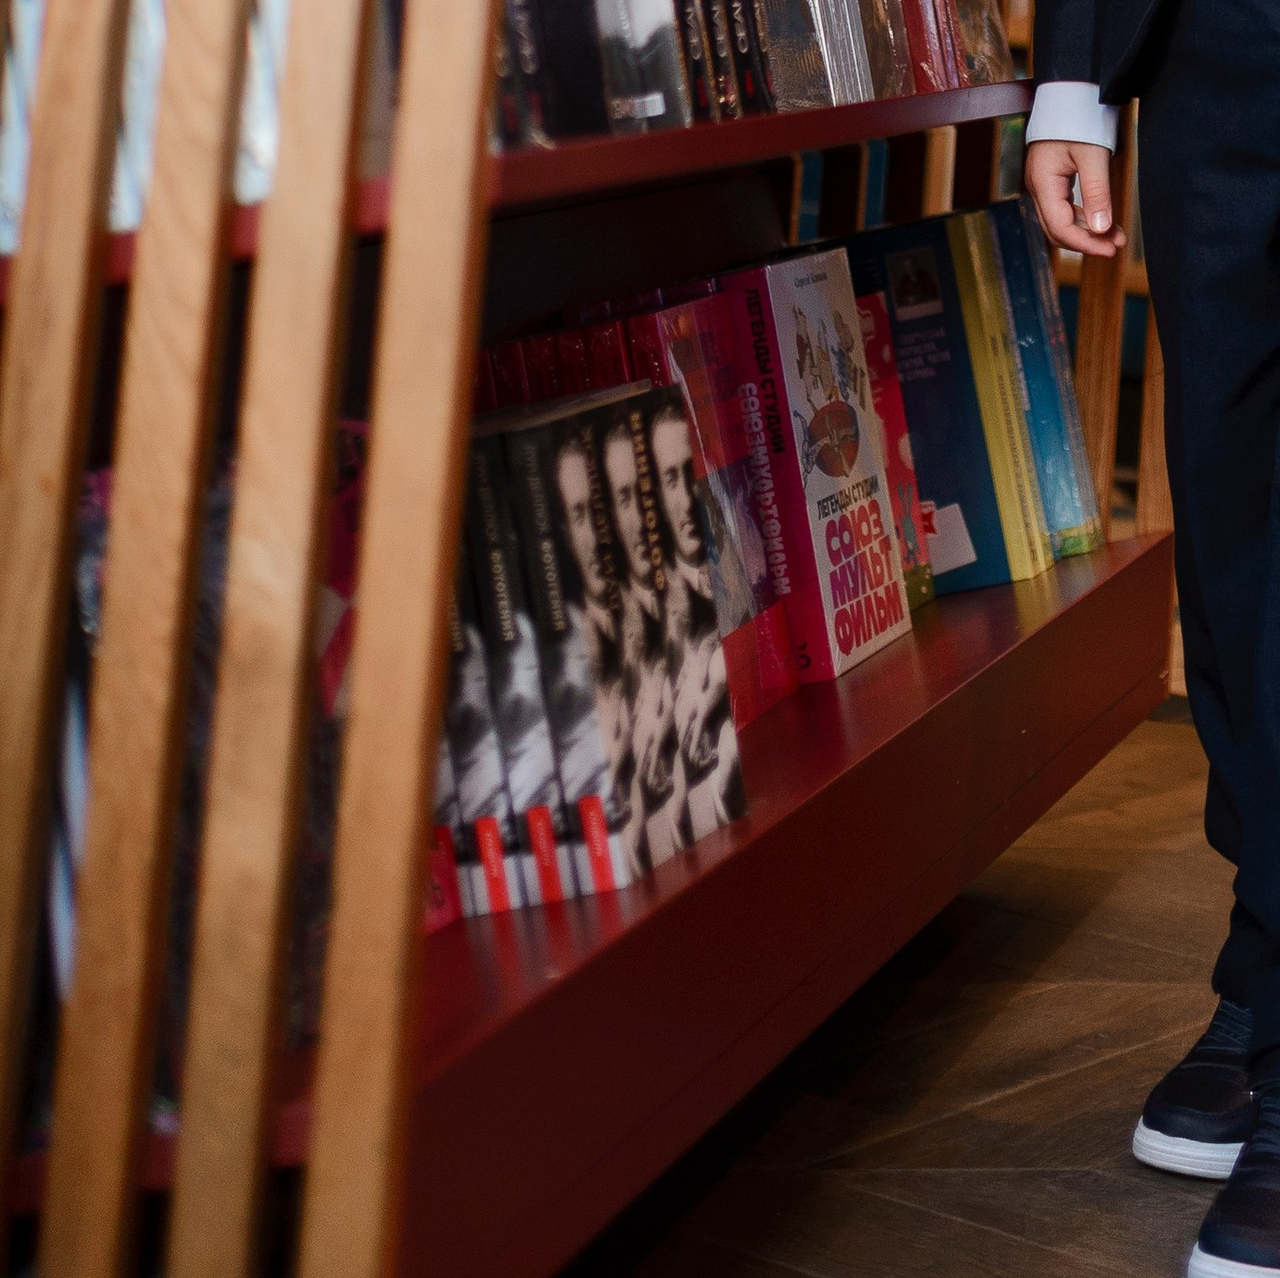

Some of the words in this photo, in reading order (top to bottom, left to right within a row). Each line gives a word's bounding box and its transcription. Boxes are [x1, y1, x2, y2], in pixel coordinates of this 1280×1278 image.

[744, 289, 773, 374] ЛЕГЕНДЫ
[763, 378, 787, 453] СТУДИИ
[816, 488, 853, 520] ЛЕГЕНДЫ
[851, 475, 880, 506] СТУДИИ
[826, 499, 885, 566] СОЮЗ
[490, 550, 515, 641] ФОТОГЕНИЯ
[540, 540, 566, 631] ФОТОГЕНИЯ
[829, 536, 894, 609] МУЛЬТ
[834, 581, 904, 656] ФИЛЬМ
